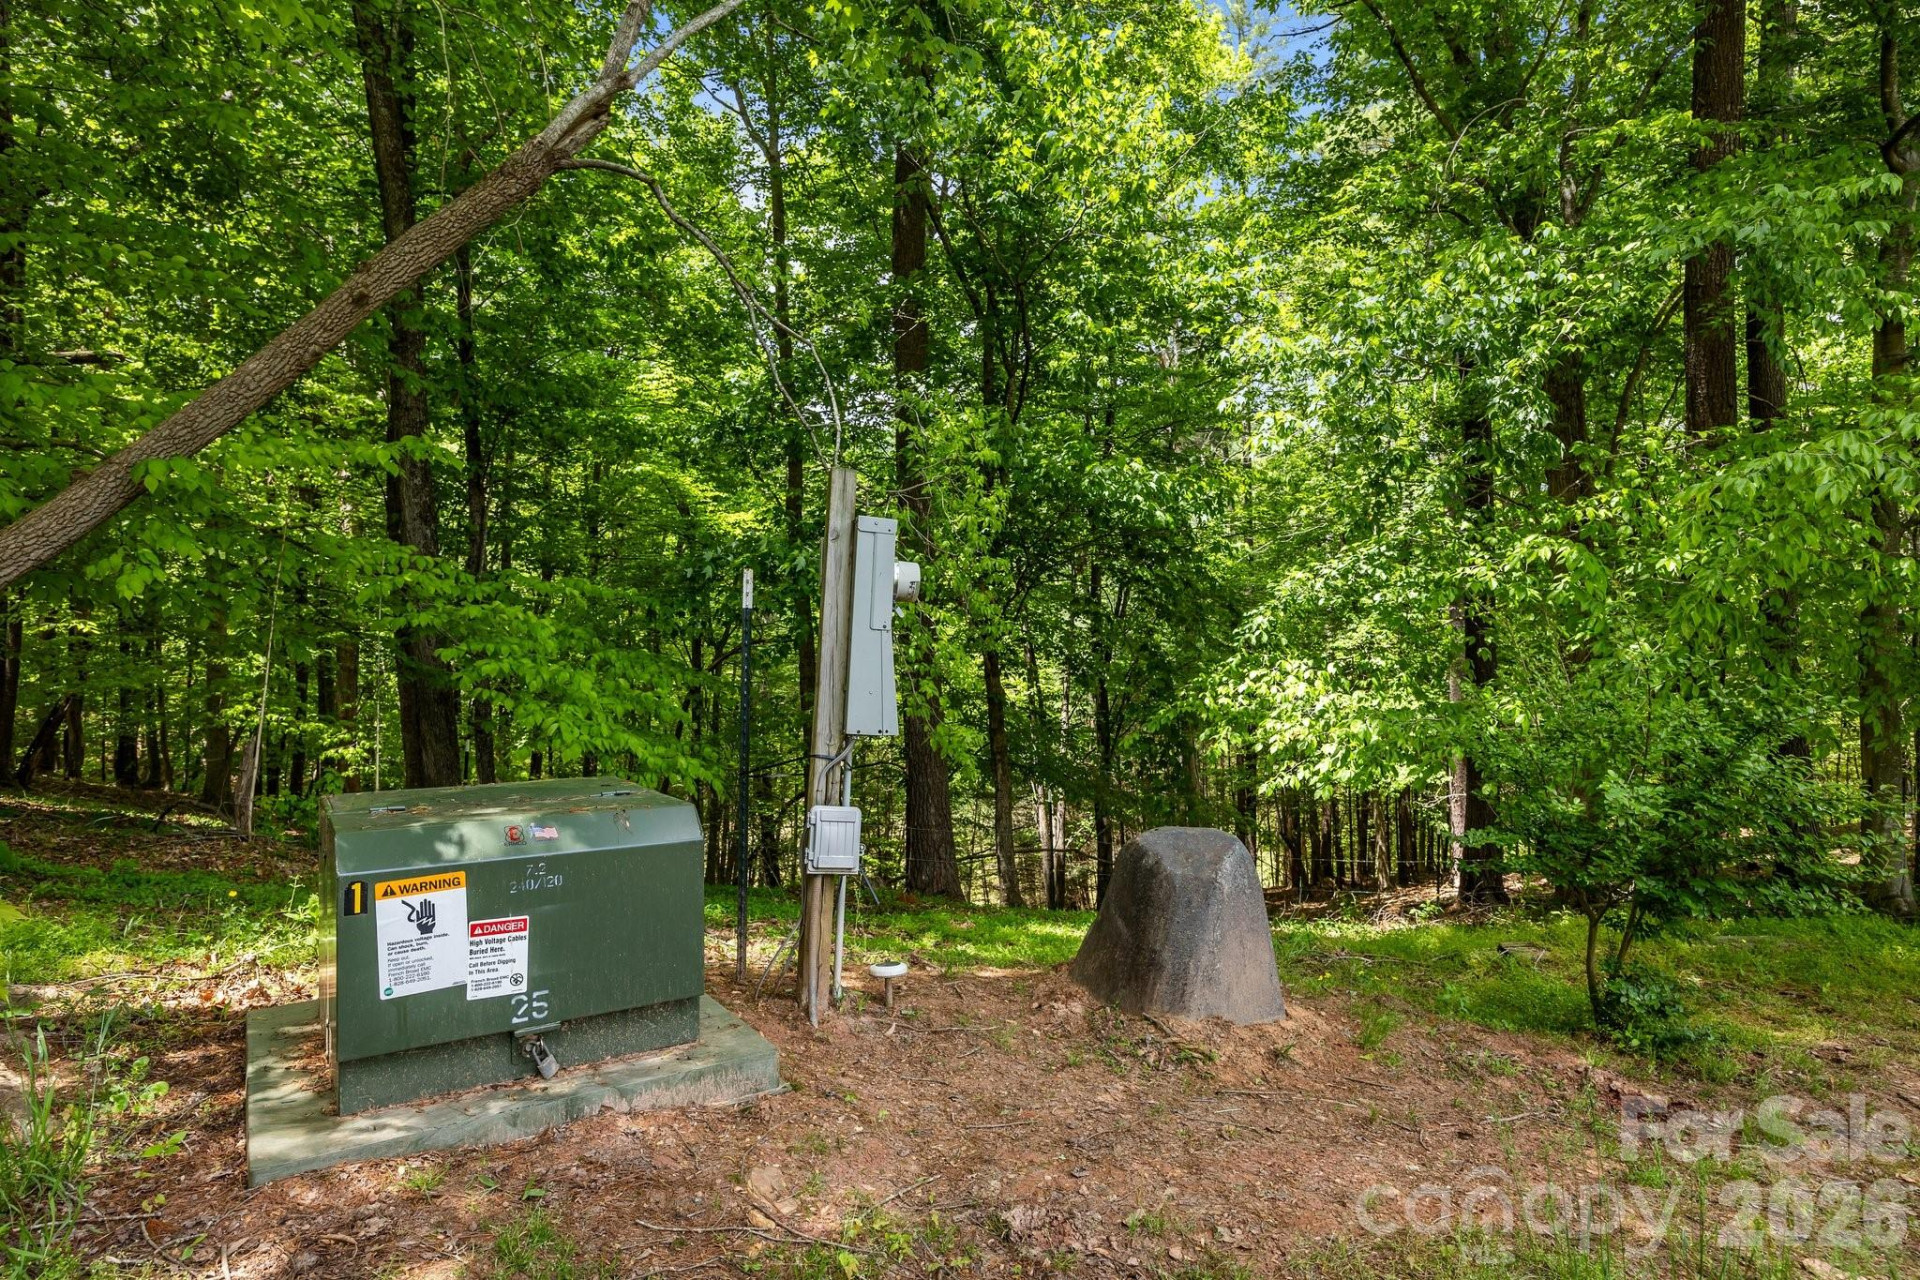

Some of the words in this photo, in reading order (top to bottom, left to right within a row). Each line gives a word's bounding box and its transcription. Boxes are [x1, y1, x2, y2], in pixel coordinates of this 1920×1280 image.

[526, 862, 546, 876] 7.2
[398, 877, 461, 894] WARNING
[352, 882, 362, 914] 1
[483, 922, 524, 933] DANGER
[511, 990, 549, 1024] 25
